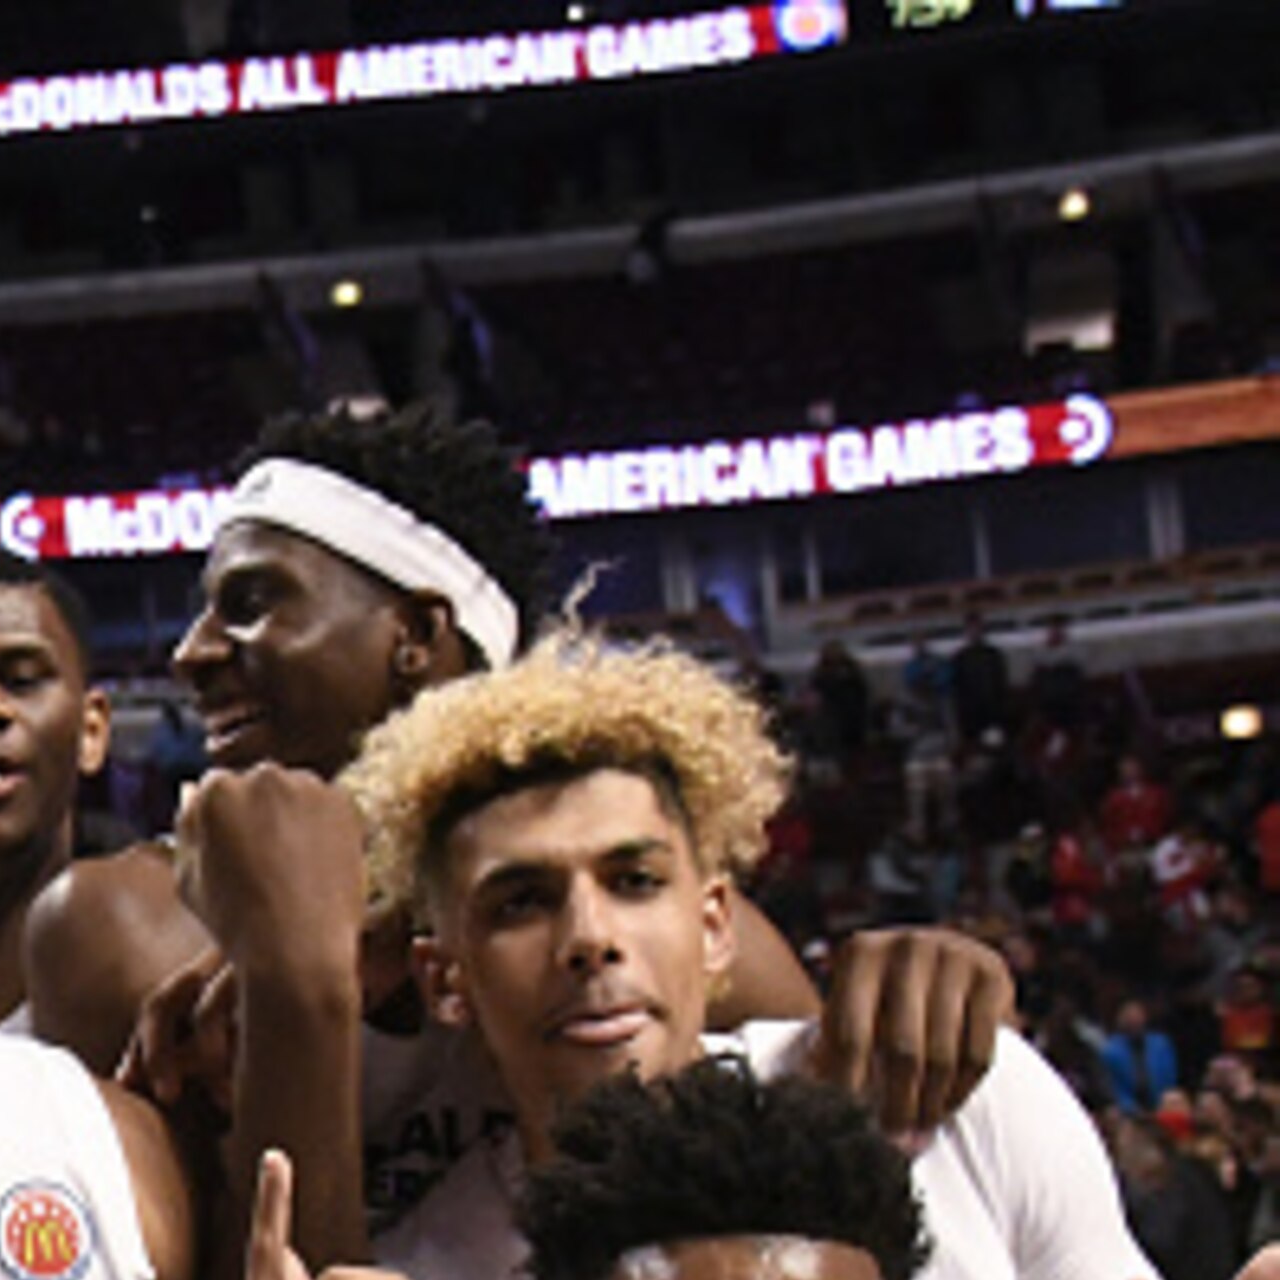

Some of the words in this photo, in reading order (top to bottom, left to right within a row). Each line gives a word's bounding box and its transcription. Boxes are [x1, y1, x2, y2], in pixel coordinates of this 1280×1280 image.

[239, 52, 331, 111] ALL
[584, 5, 754, 80] GAMES
[826, 406, 1032, 493] GAMES
